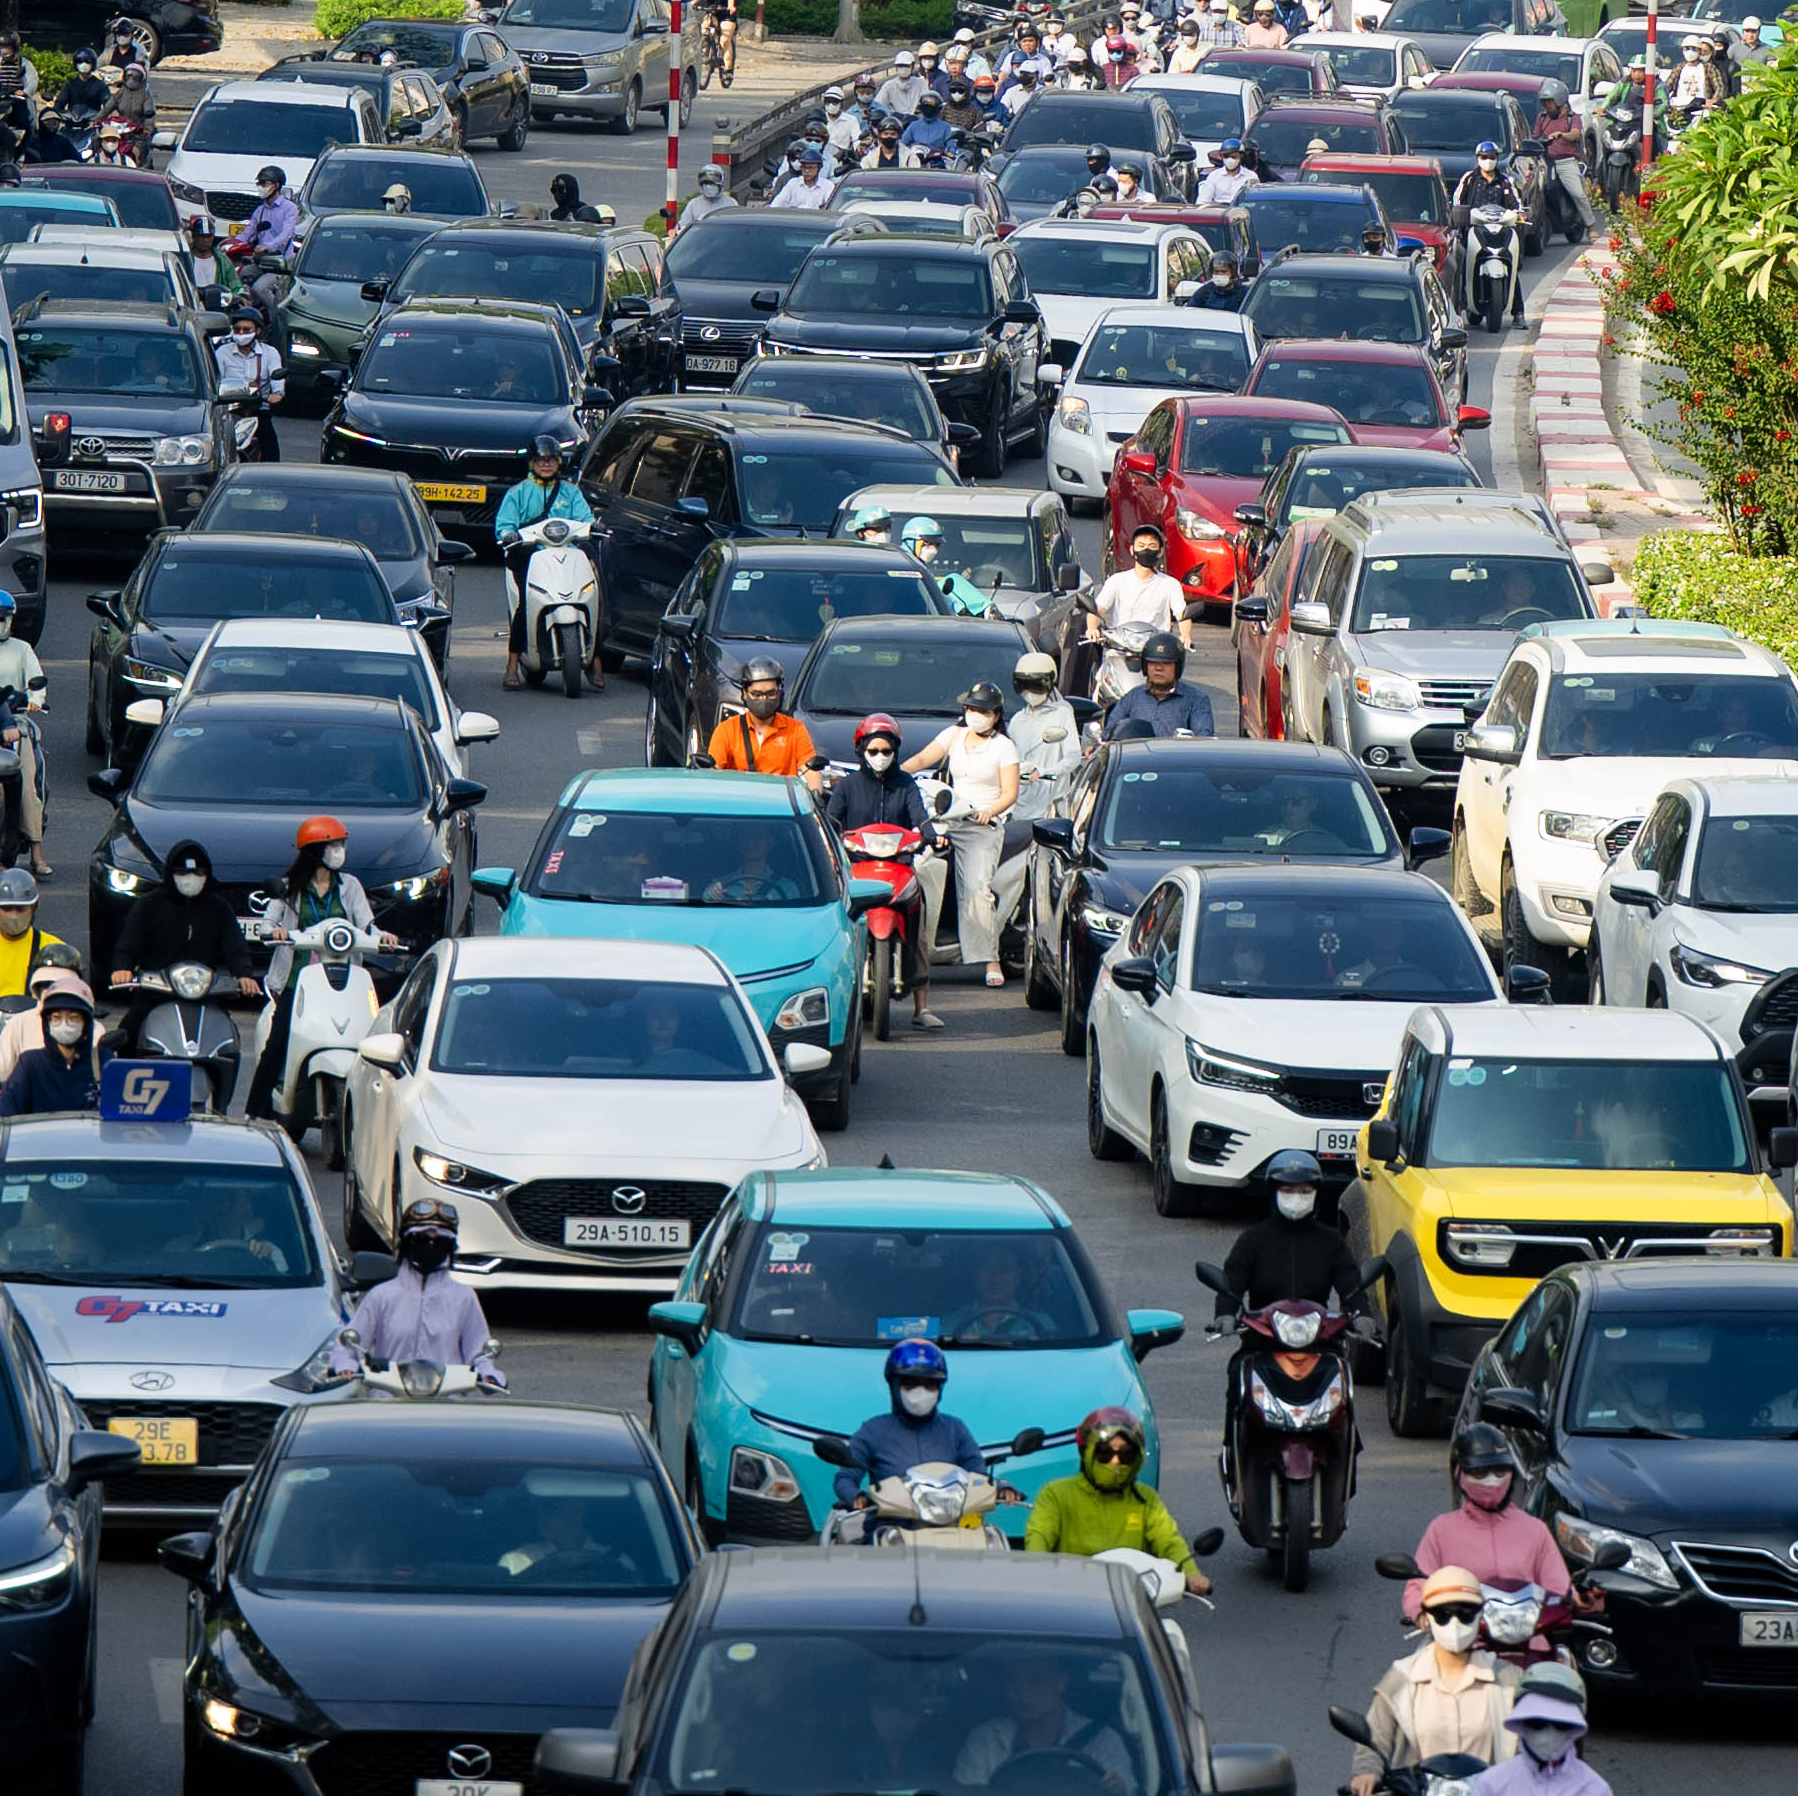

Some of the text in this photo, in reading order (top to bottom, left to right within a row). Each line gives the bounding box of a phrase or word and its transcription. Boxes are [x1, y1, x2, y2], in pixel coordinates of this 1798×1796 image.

[687, 357, 736, 372] 0A-977.16
[59, 474, 118, 490] 30T-7120
[122, 1068, 171, 1115] G7
[576, 1224, 680, 1244] 29A-510.15
[768, 1262, 813, 1274] TAXI
[145, 1301, 221, 1315] TAXI
[134, 1422, 172, 1441] 29E
[143, 1443, 188, 1461] 3.78
